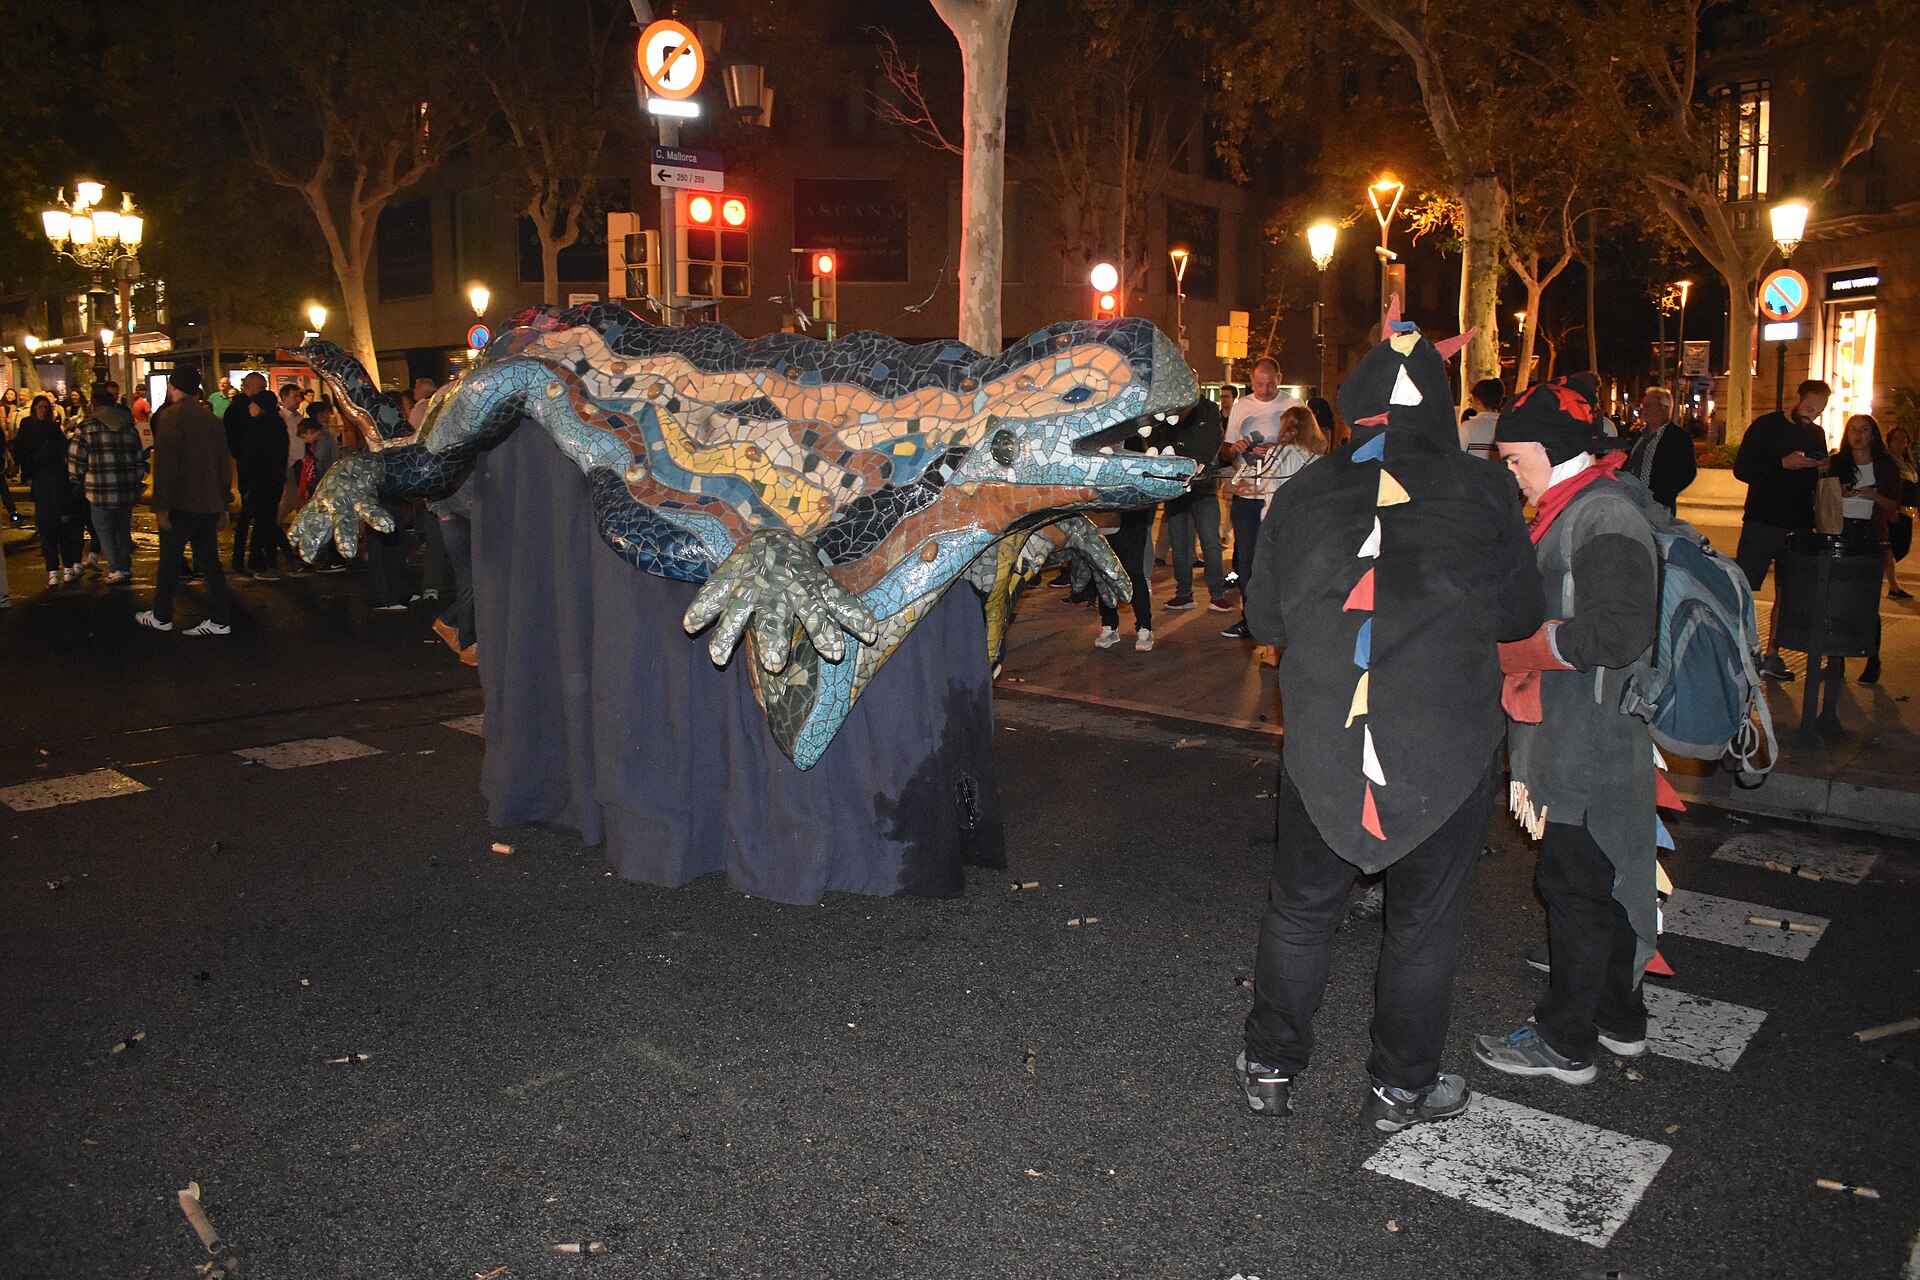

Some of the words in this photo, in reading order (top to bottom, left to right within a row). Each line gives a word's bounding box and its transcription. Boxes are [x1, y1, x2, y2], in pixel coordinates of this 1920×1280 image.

[655, 149, 664, 159] C.
[666, 150, 698, 163] Mallorca
[676, 173, 688, 182] 250
[694, 175, 705, 184] 259
